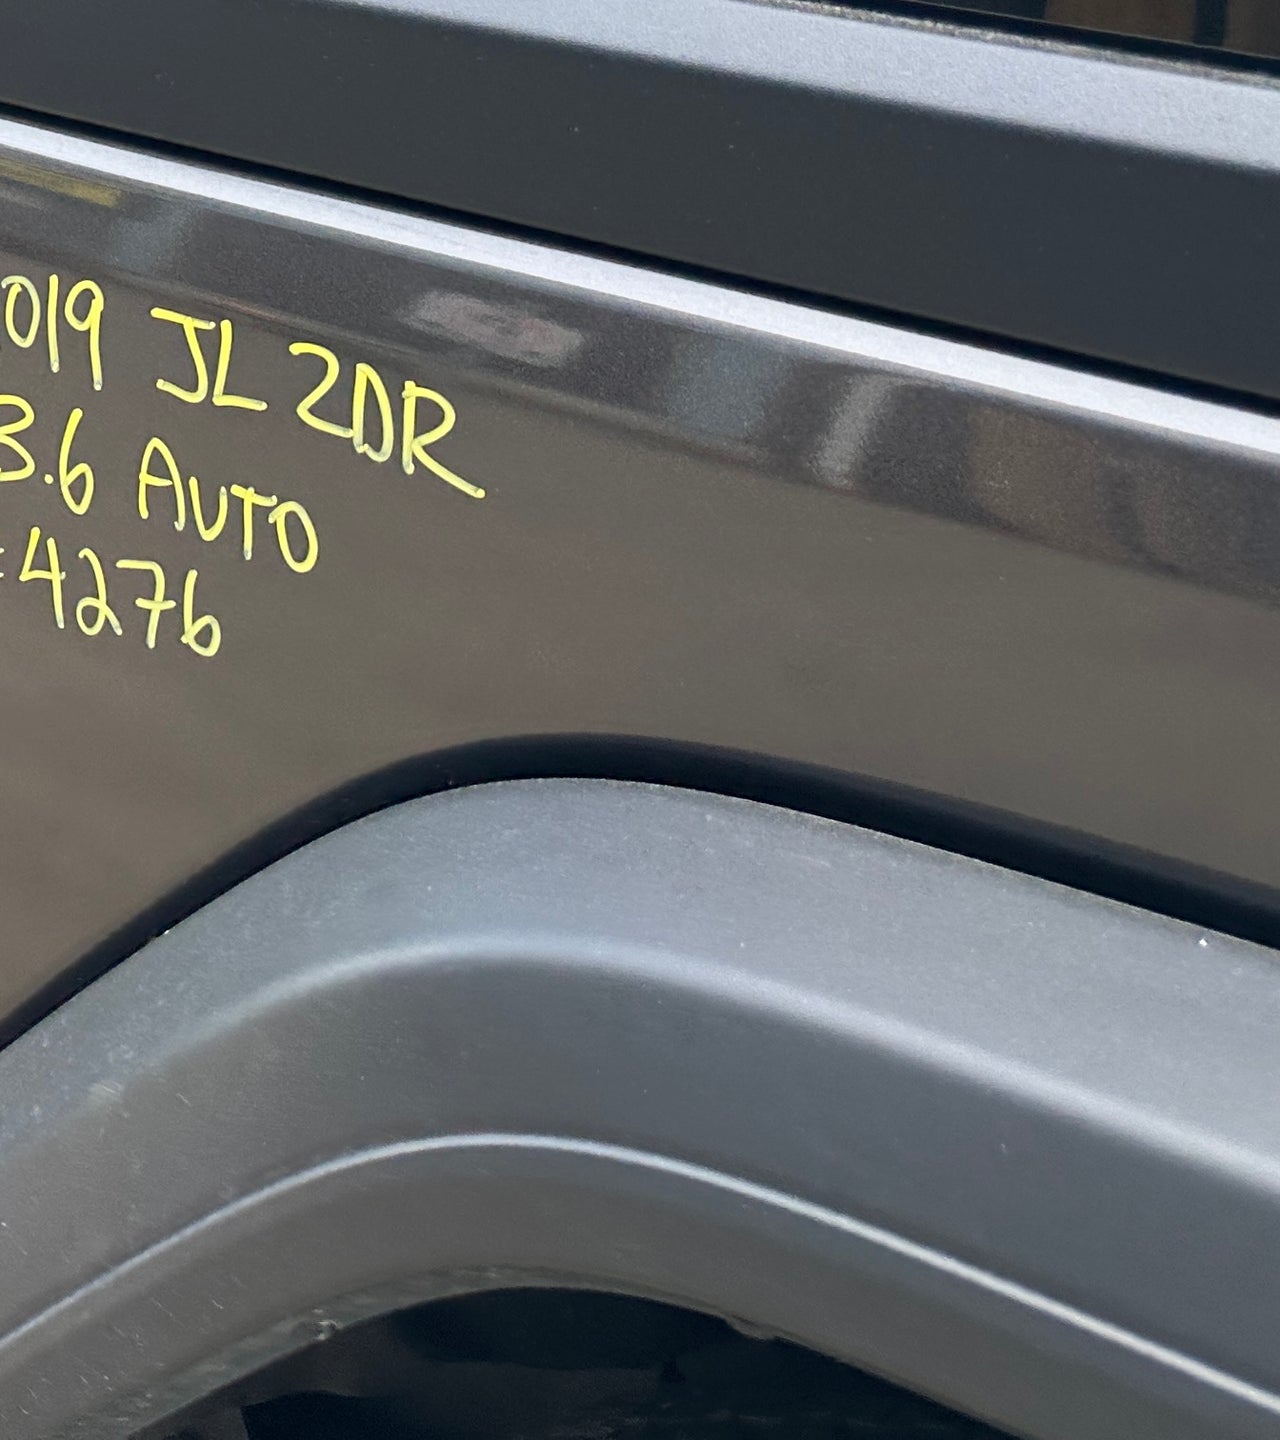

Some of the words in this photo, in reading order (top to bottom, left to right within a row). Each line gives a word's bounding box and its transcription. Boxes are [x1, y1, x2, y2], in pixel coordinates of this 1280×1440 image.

[149, 306, 269, 412] JL
[288, 340, 487, 500] 2DR
[137, 435, 321, 574] AUTO
